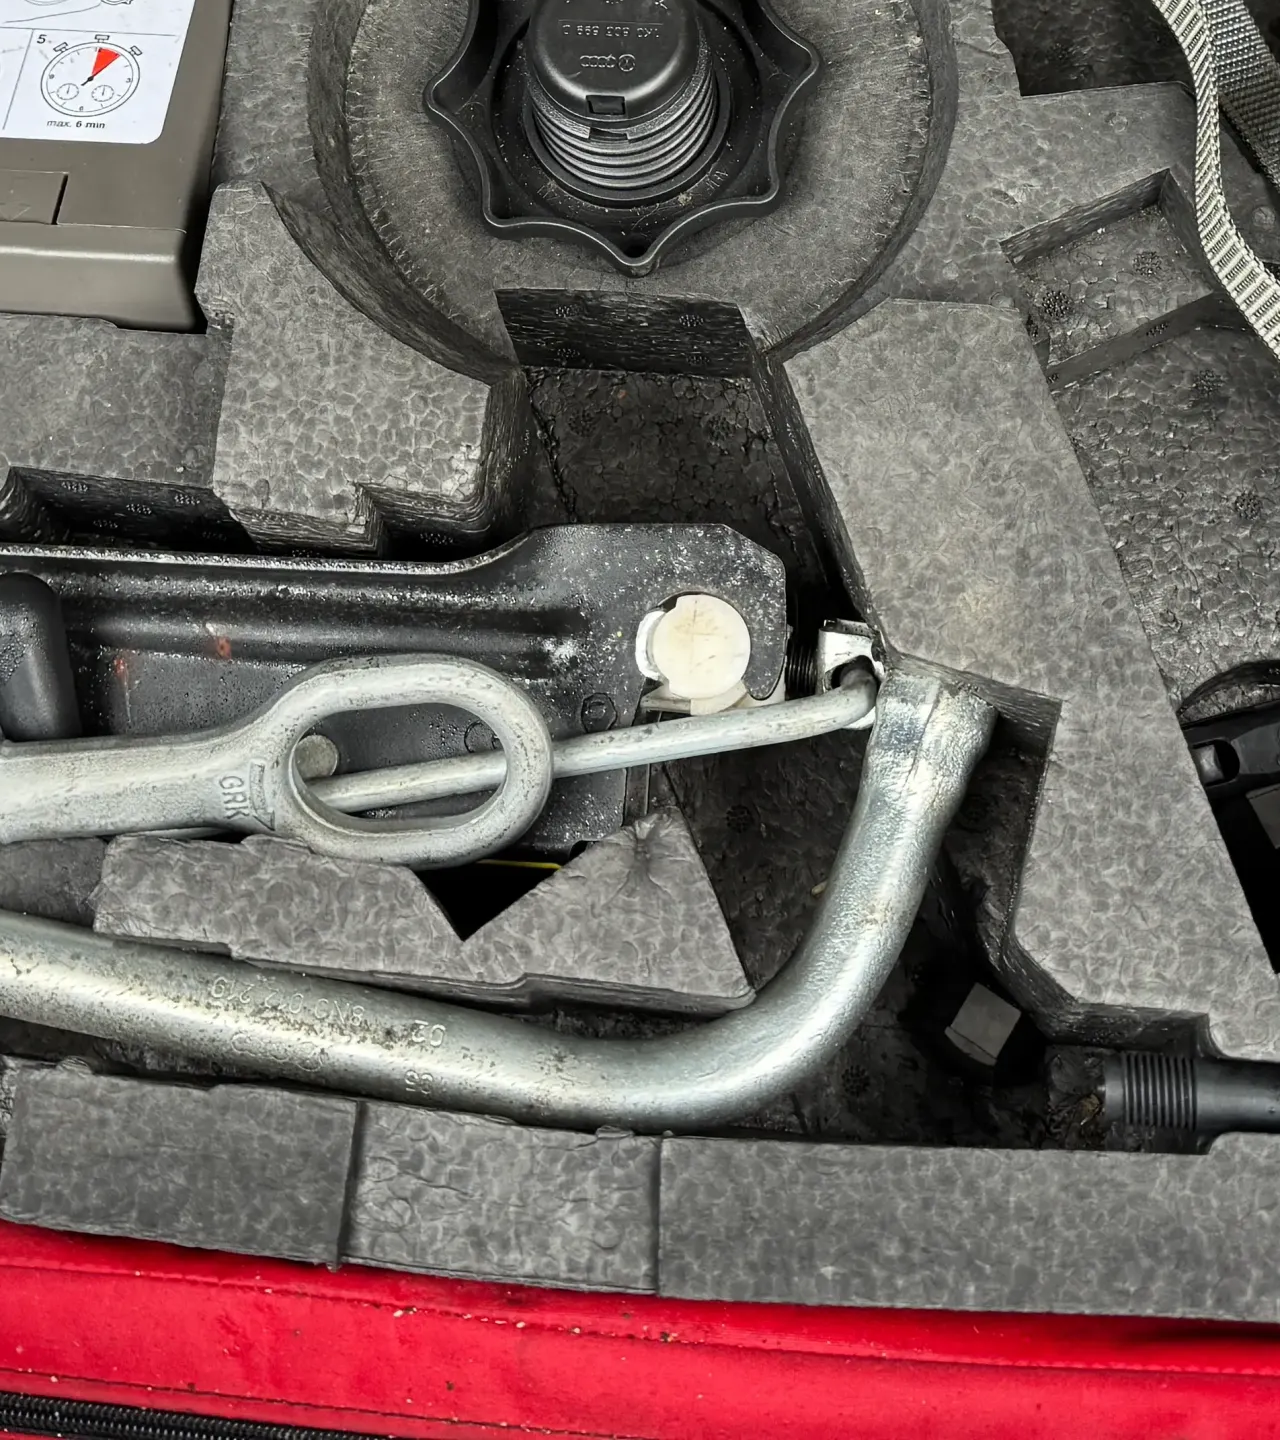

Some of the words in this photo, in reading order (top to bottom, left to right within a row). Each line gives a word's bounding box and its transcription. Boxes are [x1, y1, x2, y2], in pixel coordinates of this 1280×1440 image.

[37, 34, 46, 44] 5
[47, 120, 71, 128] max.
[218, 775, 250, 820] GRK
[212, 977, 255, 1004] 219
[264, 988, 304, 1014] 012
